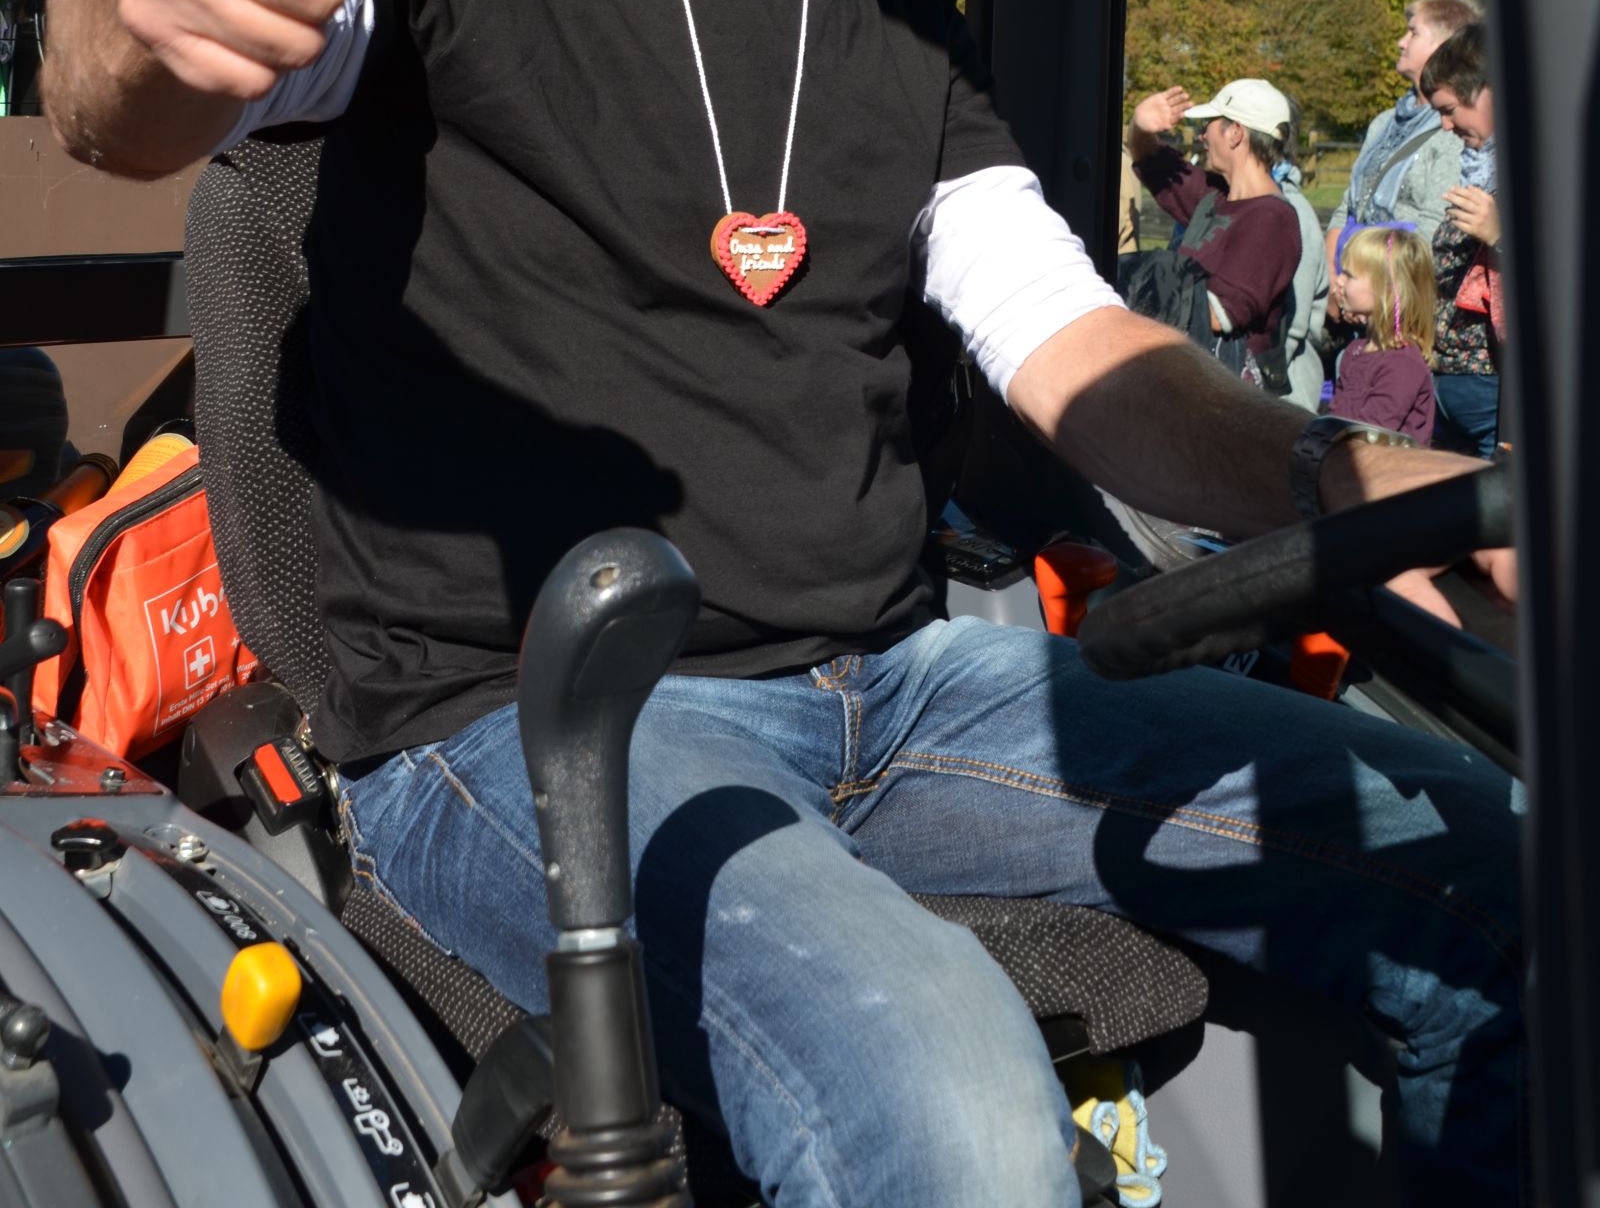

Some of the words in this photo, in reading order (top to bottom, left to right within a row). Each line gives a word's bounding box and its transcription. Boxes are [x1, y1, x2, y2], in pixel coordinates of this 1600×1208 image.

[768, 236, 795, 253] and
[741, 254, 785, 276] friends
[169, 696, 188, 712] Erste
[205, 680, 218, 692] Set
[182, 704, 195, 715] DIN
